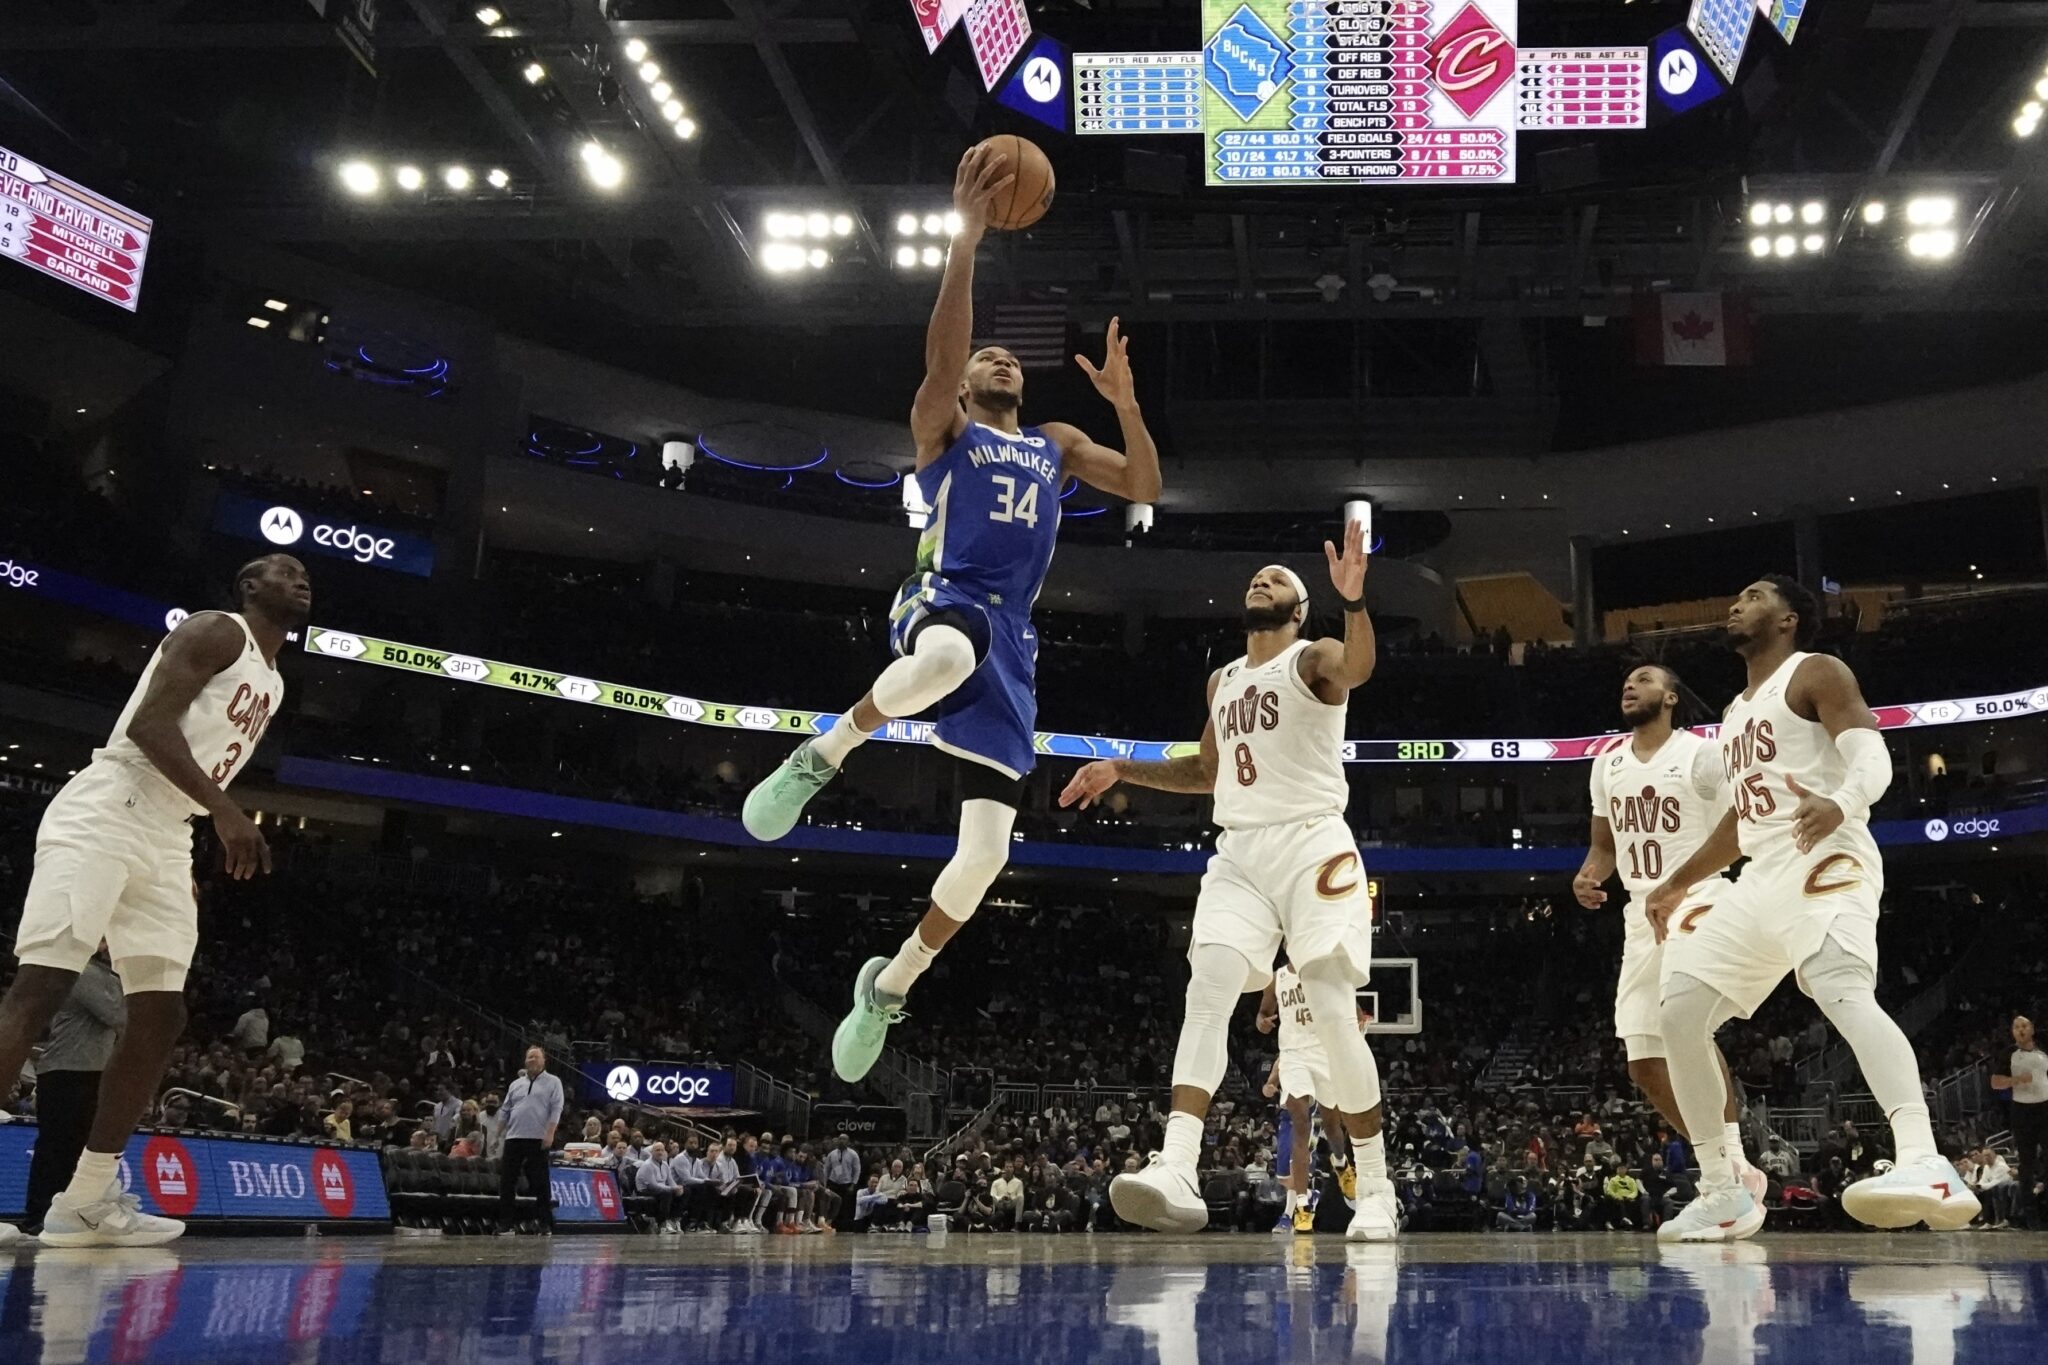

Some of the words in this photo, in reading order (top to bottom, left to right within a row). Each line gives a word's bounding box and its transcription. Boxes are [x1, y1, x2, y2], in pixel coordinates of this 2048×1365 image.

[1339, 19, 1380, 30] BLOKS
[1406, 19, 1414, 28] 2
[1306, 36, 1314, 46] 2
[1340, 36, 1380, 46] STEALS
[1406, 35, 1414, 45] 5
[1223, 40, 1265, 76] BUCKS
[1306, 52, 1314, 62] 7
[1338, 52, 1358, 62] OFF
[1360, 52, 1381, 62] REB
[1406, 52, 1414, 62] 2
[1162, 69, 1166, 77] 1
[1185, 69, 1192, 77] 0
[1338, 69, 1358, 79] DEF
[1360, 69, 1381, 78] REB
[1405, 68, 1416, 78] 11
[1528, 65, 1535, 73] 3
[1555, 65, 1562, 73] 2
[1580, 65, 1585, 73] 1
[1604, 65, 1609, 73] 1
[1627, 64, 1631, 72] 1
[1088, 83, 1094, 91] 5
[1138, 82, 1146, 90] 2
[1161, 82, 1168, 90] 3
[1185, 82, 1192, 90] 2
[1332, 85, 1388, 95] TURNOVERS
[1404, 84, 1414, 94] 3
[1527, 78, 1535, 86] 4
[1553, 78, 1564, 86] 12
[1579, 77, 1586, 86] 3
[1602, 77, 1609, 85] 2
[1627, 77, 1631, 85] 1
[1161, 95, 1168, 103] 0
[1185, 94, 1192, 103] 0
[1555, 91, 1562, 99] 5
[1579, 90, 1586, 98] 2
[1602, 90, 1609, 98] 0
[1088, 108, 1096, 116] 11
[1114, 108, 1124, 116] 21
[1139, 108, 1146, 116] 2
[1185, 107, 1192, 115] 0
[1307, 102, 1316, 112] 7
[1333, 102, 1366, 112] TOTAL
[1368, 102, 1388, 112] FLS
[1402, 101, 1416, 111] 13
[1525, 104, 1537, 112] 10
[1580, 103, 1584, 111] 1
[1624, 102, 1632, 111] 0
[1085, 121, 1099, 129] 34
[1186, 120, 1193, 128] 0
[1302, 118, 1318, 128] 27
[1334, 118, 1366, 128] BENCH
[1367, 118, 1386, 127] PTS
[1524, 117, 1538, 125] 45
[1578, 116, 1585, 124] 0
[1601, 116, 1609, 124] 2
[1626, 115, 1630, 124] 1
[1328, 134, 1356, 144] FIELD
[1358, 134, 1392, 143] GOALS
[1460, 133, 1497, 144] 50.0%
[1329, 150, 1392, 160] 3-POINTERS
[1460, 149, 1497, 160] 50.0%
[1324, 166, 1350, 176] FREE
[1351, 166, 1397, 176] THROWS
[1462, 165, 1497, 176] 87.5%
[6, 204, 19, 217] 18
[52, 224, 116, 262] MITCHELL
[56, 202, 126, 248] CAVALIERS
[4, 222, 13, 232] 4
[65, 248, 99, 270] LOVE
[1, 237, 10, 248] 5
[46, 256, 110, 292] GARLAND
[968, 444, 1056, 485] MILWAUKEE
[989, 474, 1039, 528] 34
[313, 524, 395, 562] edge
[330, 637, 351, 652] FG
[383, 646, 442, 670] 50.0%
[450, 660, 481, 676] 3PT
[510, 672, 556, 691] 41.7%
[570, 683, 588, 696] FT
[613, 690, 663, 710] 60.0%
[672, 702, 696, 716] TOL
[714, 709, 725, 721] 5
[744, 712, 770, 724] FLS
[790, 716, 800, 728] 0
[1218, 689, 1278, 742] CAVS
[1930, 706, 1948, 718] FG
[1975, 696, 2028, 715] 50.0%
[1398, 742, 1444, 760] 3RD
[1491, 742, 1520, 758] 63
[1723, 718, 1776, 783] CAVS
[212, 742, 242, 783] 3
[1234, 742, 1258, 786] 8
[1734, 772, 1777, 824] 45
[1611, 793, 1681, 833] CAVS
[1954, 817, 2000, 838] edge
[1628, 840, 1662, 880] 10
[1281, 984, 1306, 1008] CAV
[646, 1071, 710, 1104] edge
[836, 1118, 876, 1131] clover
[228, 1160, 305, 1199] BMO
[550, 1180, 590, 1208] BMO
